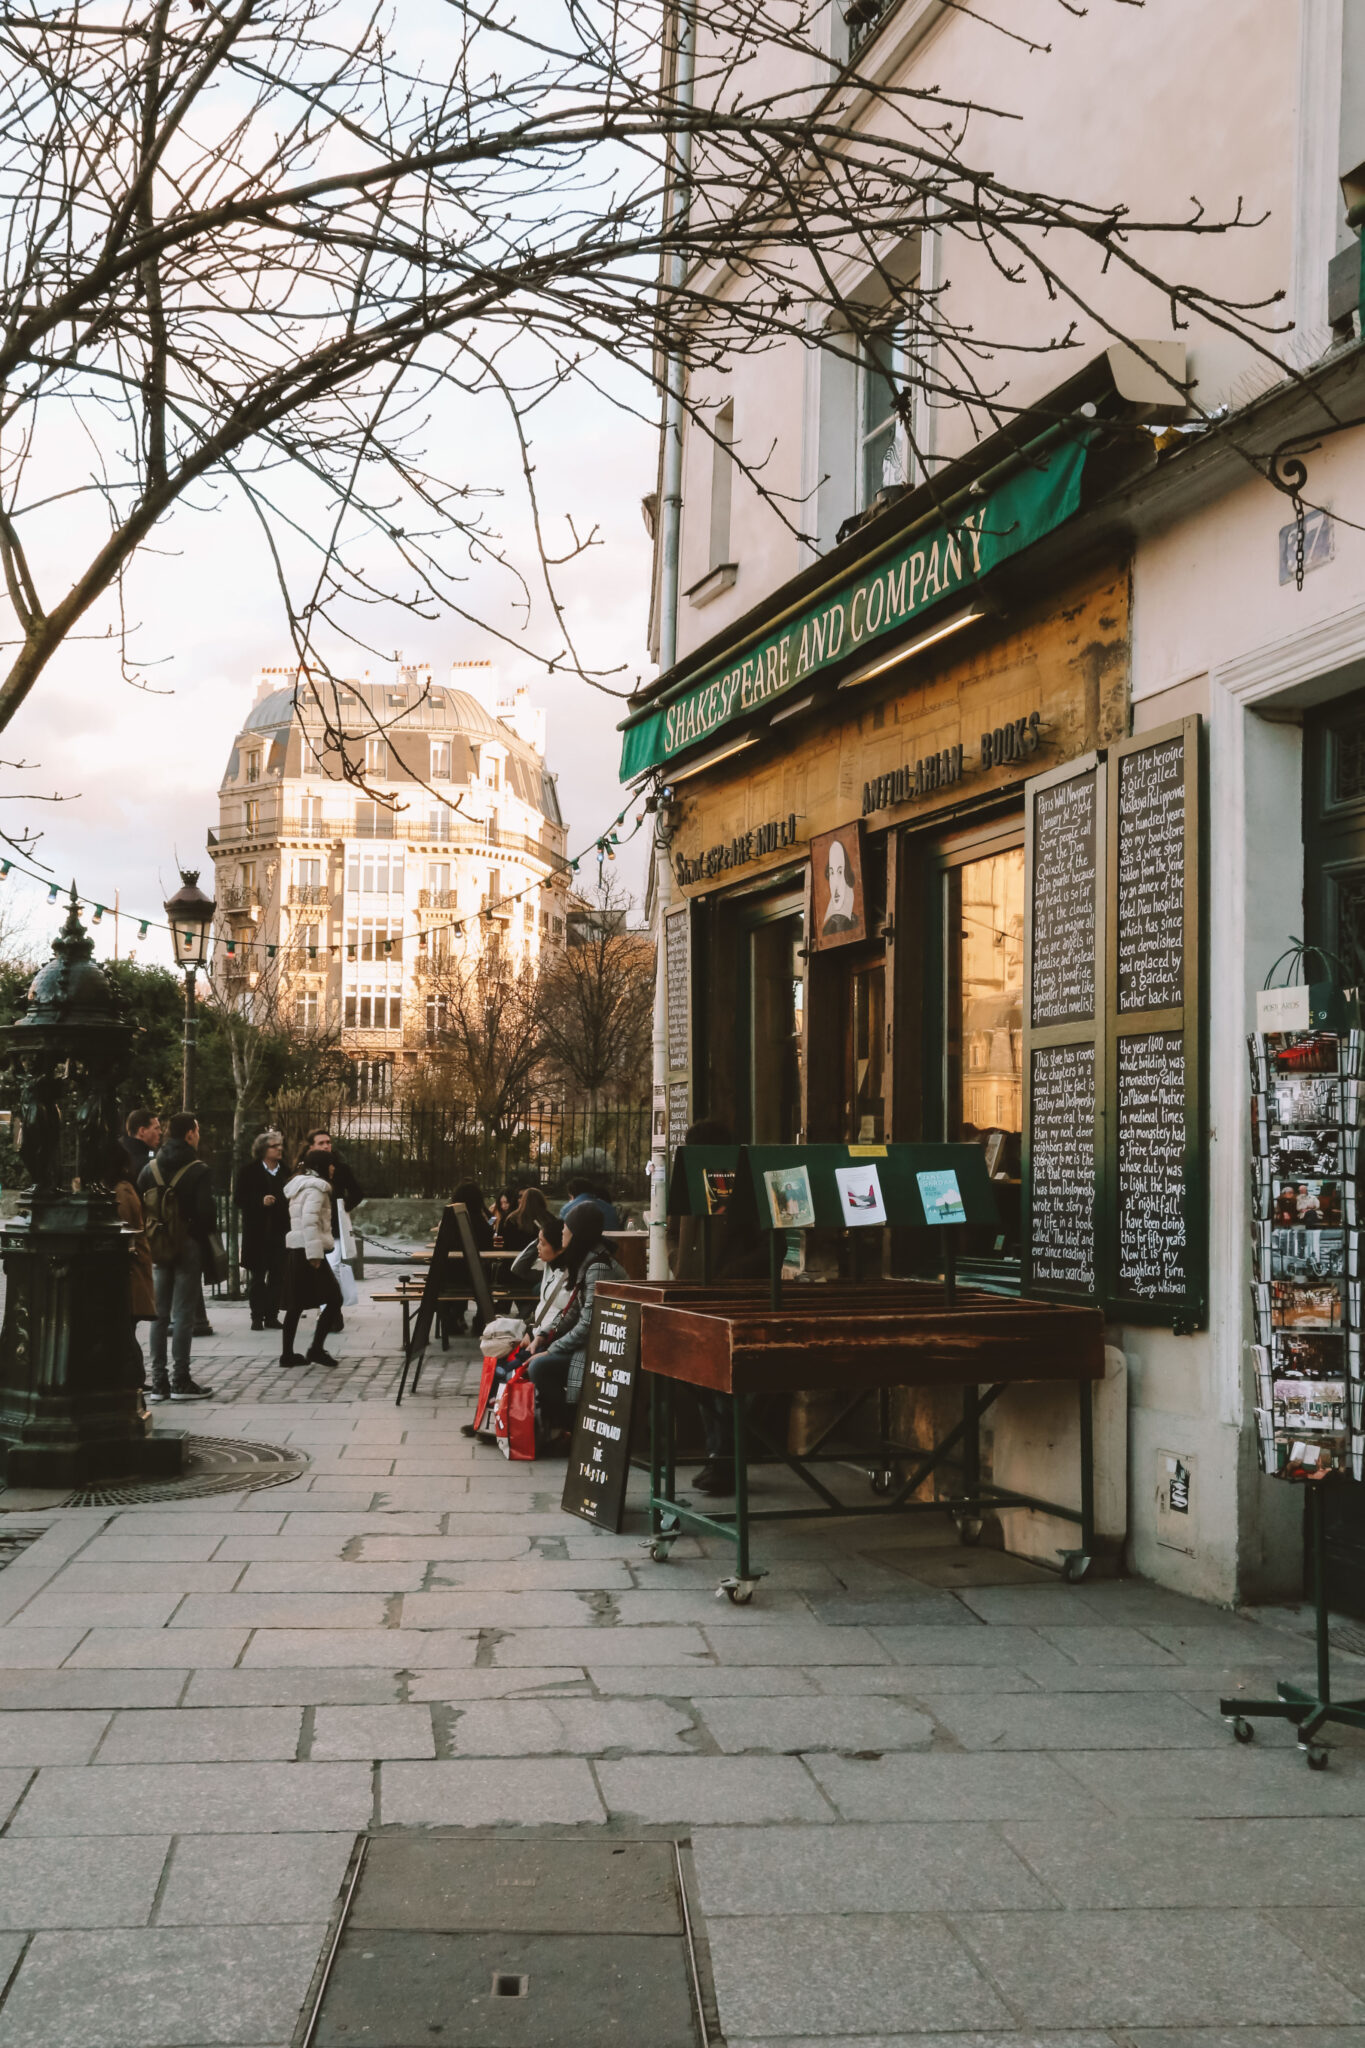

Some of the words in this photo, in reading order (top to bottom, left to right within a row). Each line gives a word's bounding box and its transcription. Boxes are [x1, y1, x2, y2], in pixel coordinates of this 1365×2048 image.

[665, 635, 790, 753] SHAKESPEARE
[795, 603, 845, 677] AND
[851, 507, 986, 642] COMPANY
[862, 743, 963, 816] ANTIQUARIAN
[981, 711, 1040, 771] BOOKS
[1122, 758, 1134, 779] for
[1138, 754, 1152, 771] the
[1154, 746, 1184, 767] heroine
[1121, 781, 1126, 794] a
[1128, 771, 1145, 798] girl
[1147, 761, 1178, 785] called
[1039, 796, 1053, 814] Paris
[1072, 798, 1092, 819] 2004
[1120, 820, 1134, 835] One
[1135, 810, 1165, 830] hundred
[1167, 808, 1185, 829] years
[1040, 835, 1056, 851] Some
[1081, 820, 1091, 835] call
[1120, 838, 1132, 855] ago
[1134, 836, 1146, 849] my
[1148, 823, 1184, 844] bookstore
[1056, 845, 1067, 859] the
[1069, 840, 1084, 855] Don
[1120, 853, 1133, 867] was
[1144, 845, 1162, 859] wine
[1164, 841, 1182, 859] shop
[1037, 861, 1065, 880] Quixote
[1076, 854, 1088, 868] the
[1120, 866, 1139, 882] hidden
[1141, 859, 1154, 883] from
[1156, 857, 1166, 873] the
[1036, 879, 1051, 896] Latin
[1072, 868, 1095, 883] because
[1129, 887, 1136, 898] an
[1138, 882, 1159, 895] annex
[1161, 872, 1170, 895] of
[1171, 873, 1184, 888] the
[1046, 889, 1062, 907] head
[1137, 899, 1151, 916] Dieu
[1153, 891, 1183, 915] hospital
[1057, 905, 1066, 920] the
[1069, 900, 1092, 916] clouds
[1054, 924, 1063, 935] can
[1085, 913, 1094, 929] all
[1120, 918, 1143, 938] which
[1145, 916, 1158, 932] has
[1161, 915, 1182, 930] since
[1087, 932, 1093, 944] in
[1120, 942, 1135, 956] been
[1138, 929, 1183, 952] demolished
[1120, 958, 1132, 974] and
[1134, 950, 1169, 975] replaced
[1172, 951, 1181, 973] by
[1131, 976, 1136, 987] a
[1139, 969, 1177, 991] garden.
[1120, 990, 1146, 1010] Further
[1149, 986, 1169, 1004] back
[1172, 986, 1181, 1002] in
[1037, 998, 1067, 1023] frustrated
[1120, 1040, 1131, 1054] the
[1133, 1043, 1147, 1057] year
[1148, 1036, 1163, 1052] 1600
[1166, 1040, 1182, 1051] our
[1034, 1051, 1048, 1068] This
[1076, 1049, 1094, 1061] rooms
[1120, 1056, 1138, 1071] whole
[1139, 1054, 1168, 1076] building
[1169, 1057, 1185, 1068] was
[1049, 1066, 1076, 1084] chapters
[1120, 1076, 1124, 1087] a
[1126, 1070, 1160, 1093] monastery
[1161, 1070, 1184, 1085] called
[1034, 1082, 1049, 1095] novel
[1129, 1088, 1149, 1105] Maison
[1033, 1096, 1054, 1115] Tolstoy
[1120, 1110, 1127, 1125] In
[1129, 1107, 1157, 1123] medieval
[1162, 1106, 1183, 1123] times
[1034, 1114, 1045, 1125] are
[1064, 1110, 1075, 1123] real
[1034, 1127, 1047, 1139] than
[1060, 1125, 1073, 1138] next
[1076, 1125, 1093, 1137] door
[1120, 1125, 1134, 1139] each
[1136, 1124, 1170, 1146] monastery
[1172, 1125, 1185, 1141] had
[1033, 1140, 1062, 1156] neighbors
[1065, 1139, 1076, 1151] and
[1079, 1143, 1093, 1153] even
[1120, 1145, 1124, 1156] a
[1082, 1152, 1093, 1166] the
[1120, 1157, 1141, 1173] whose
[1143, 1157, 1164, 1181] duty
[1167, 1165, 1182, 1176] was
[1077, 1166, 1095, 1184] before
[1037, 1186, 1047, 1194] was
[1049, 1181, 1061, 1195] born
[1120, 1176, 1128, 1191] to
[1130, 1175, 1148, 1198] light
[1151, 1176, 1163, 1192] the
[1165, 1177, 1186, 1202] lamps
[1033, 1198, 1051, 1212] wrote
[1054, 1196, 1064, 1211] the
[1066, 1197, 1083, 1218] story
[1126, 1195, 1135, 1210] at
[1076, 1215, 1093, 1229] book
[1126, 1211, 1142, 1228] have
[1144, 1214, 1159, 1229] been
[1162, 1215, 1185, 1235] doing
[1033, 1229, 1049, 1242] called
[1082, 1232, 1094, 1246] and
[1121, 1230, 1135, 1244] this
[1137, 1229, 1147, 1249] for
[1148, 1230, 1164, 1252] fifty
[1164, 1236, 1185, 1251] years
[1032, 1247, 1044, 1255] ever
[1045, 1245, 1062, 1258] since
[1063, 1247, 1086, 1268] reading
[1088, 1247, 1094, 1262] it
[1122, 1245, 1138, 1261] Now
[1141, 1244, 1148, 1259] it
[1151, 1246, 1157, 1258] is
[1163, 1252, 1178, 1268] my
[1037, 1261, 1049, 1278] have
[1051, 1262, 1064, 1279] been
[1120, 1261, 1160, 1285] daughter's
[1165, 1263, 1186, 1279] turn.
[593, 1447, 603, 1462] THE
